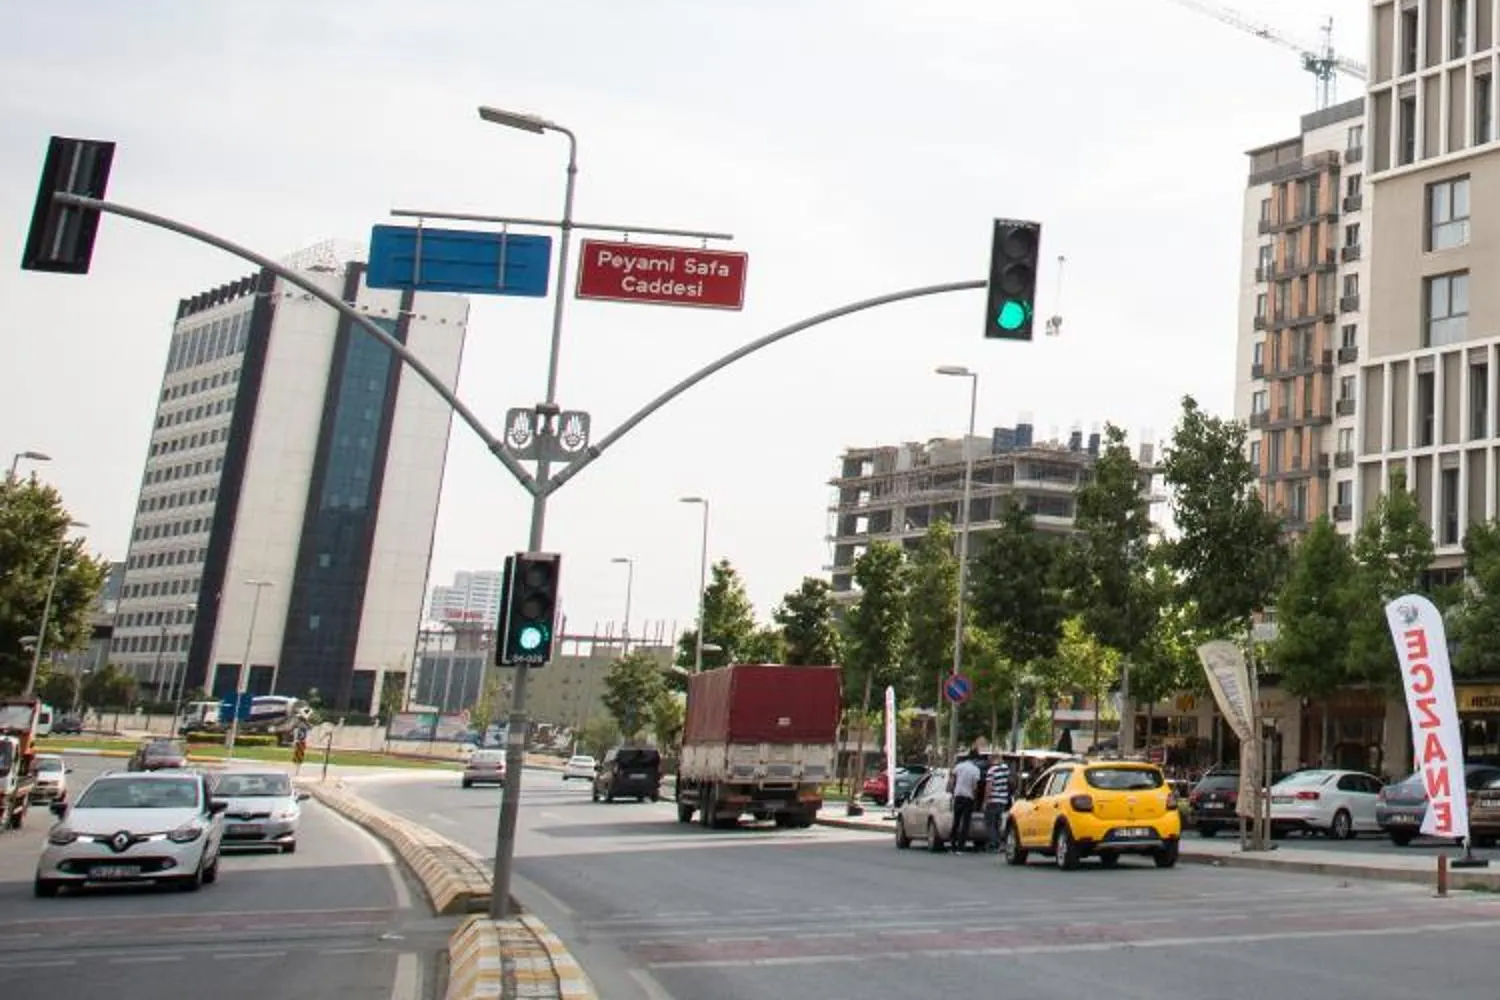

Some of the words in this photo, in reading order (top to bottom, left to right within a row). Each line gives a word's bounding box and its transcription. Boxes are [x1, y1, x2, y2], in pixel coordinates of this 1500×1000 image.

[598, 250, 675, 273] Peyami
[684, 257, 730, 278] Safa
[621, 275, 703, 298] Caddesi
